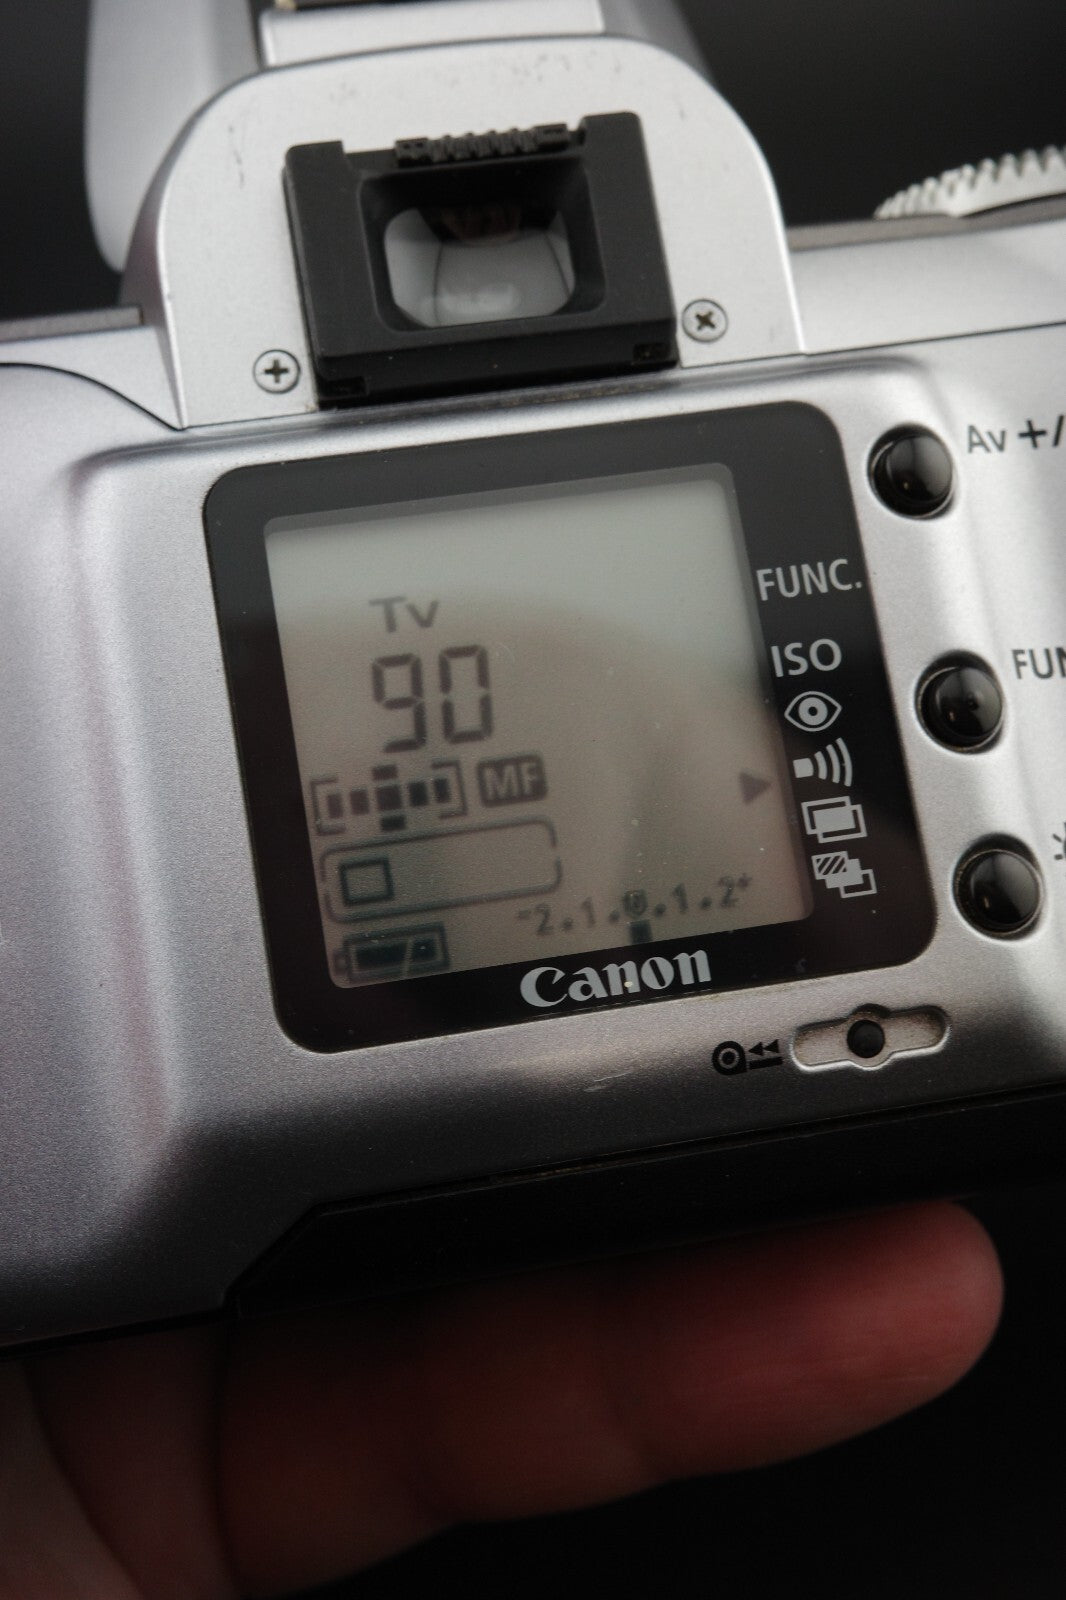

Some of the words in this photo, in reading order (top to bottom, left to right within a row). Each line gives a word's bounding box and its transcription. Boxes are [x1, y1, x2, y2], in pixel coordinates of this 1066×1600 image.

[967, 424, 1006, 453] Av
[756, 558, 863, 600] FUNC.
[369, 596, 439, 632] Tv
[770, 638, 842, 677] ISO
[371, 644, 493, 753] 90
[483, 761, 541, 801] MF
[520, 950, 711, 1007] Canon
